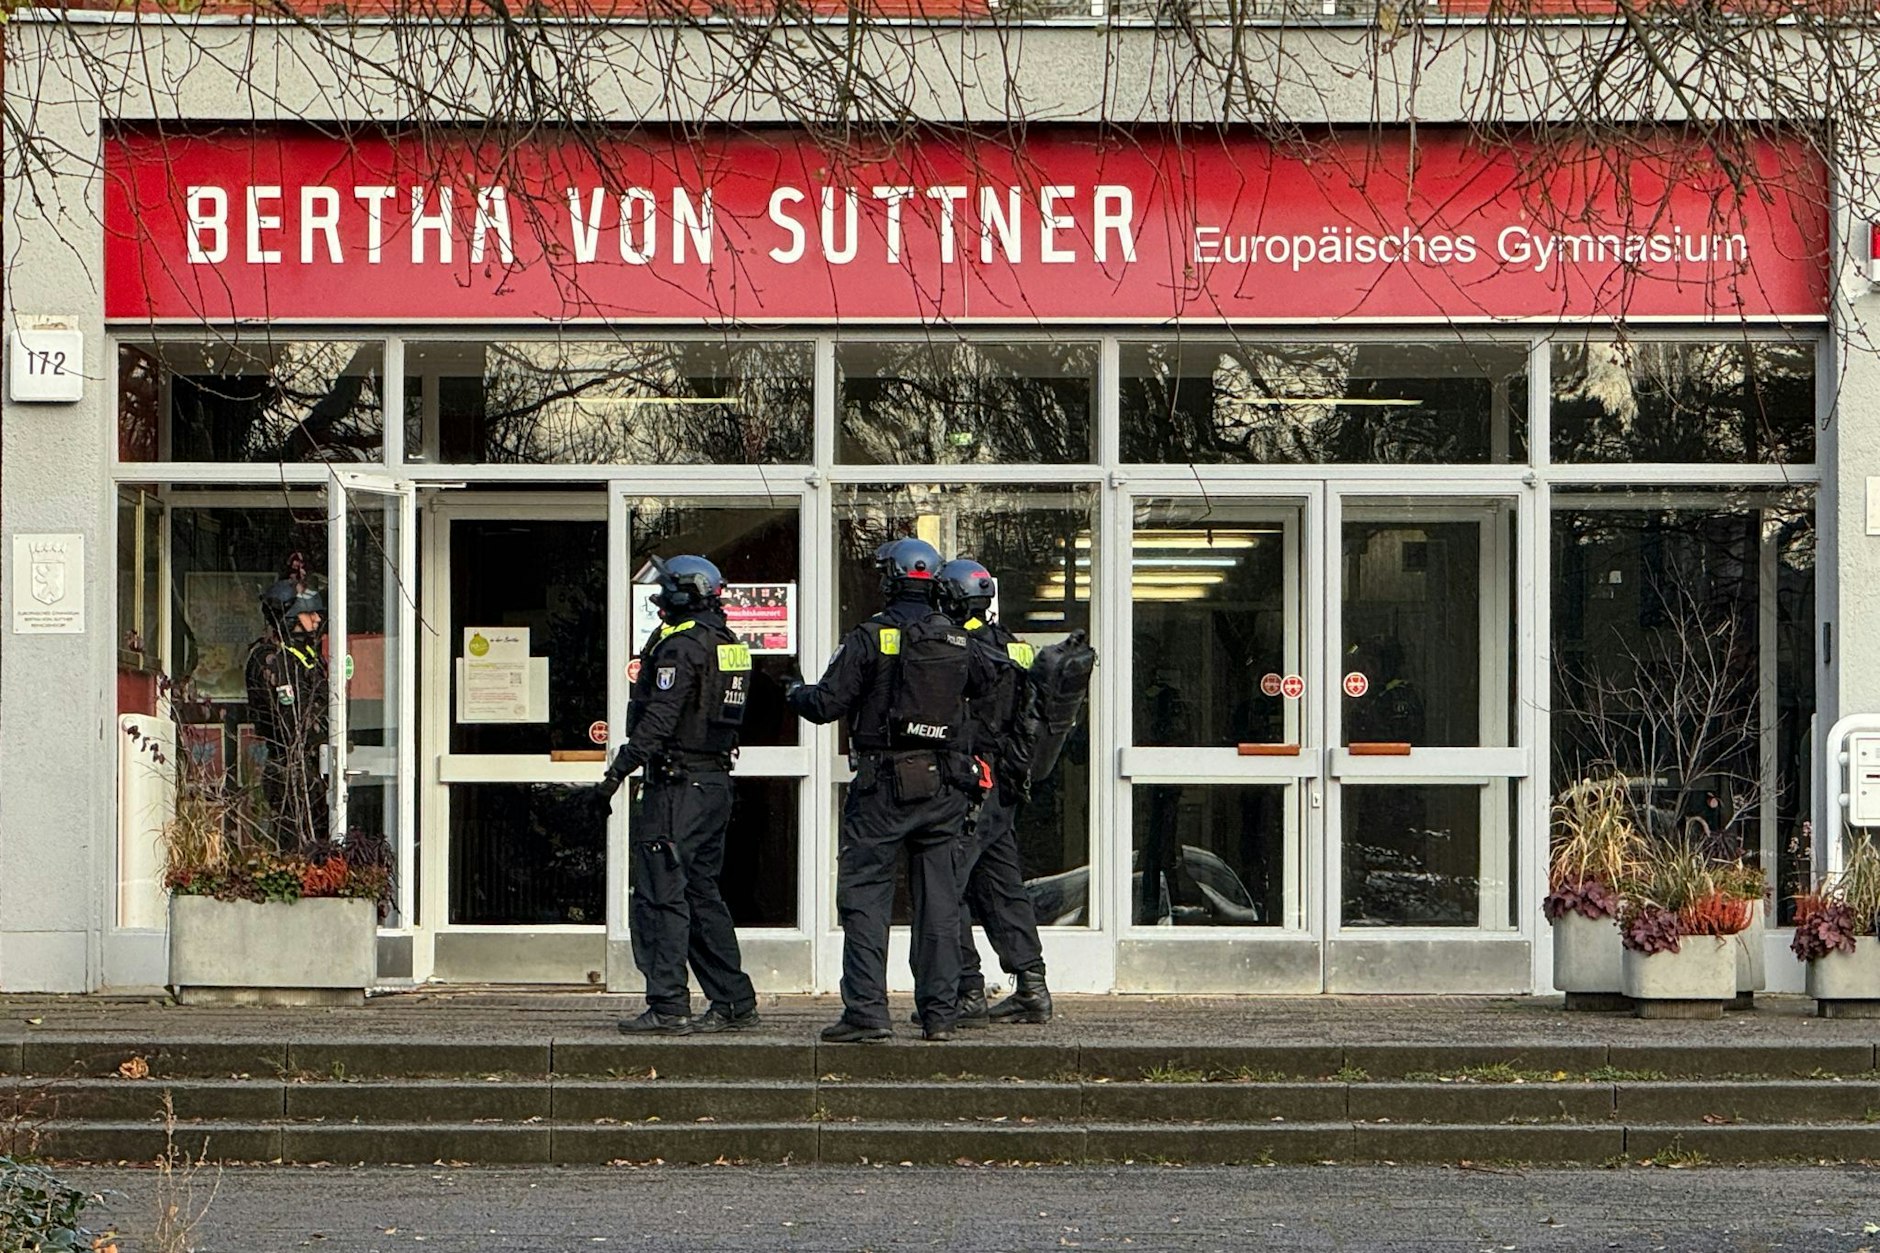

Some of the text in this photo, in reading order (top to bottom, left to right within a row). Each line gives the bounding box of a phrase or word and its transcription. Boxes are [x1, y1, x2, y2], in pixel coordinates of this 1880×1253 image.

[187, 185, 1138, 265] BERTHA VON SUTTNER
[1194, 225, 1748, 272] Europäisches Gymnasium
[28, 351, 66, 375] 172
[906, 722, 948, 739] MEDIC
